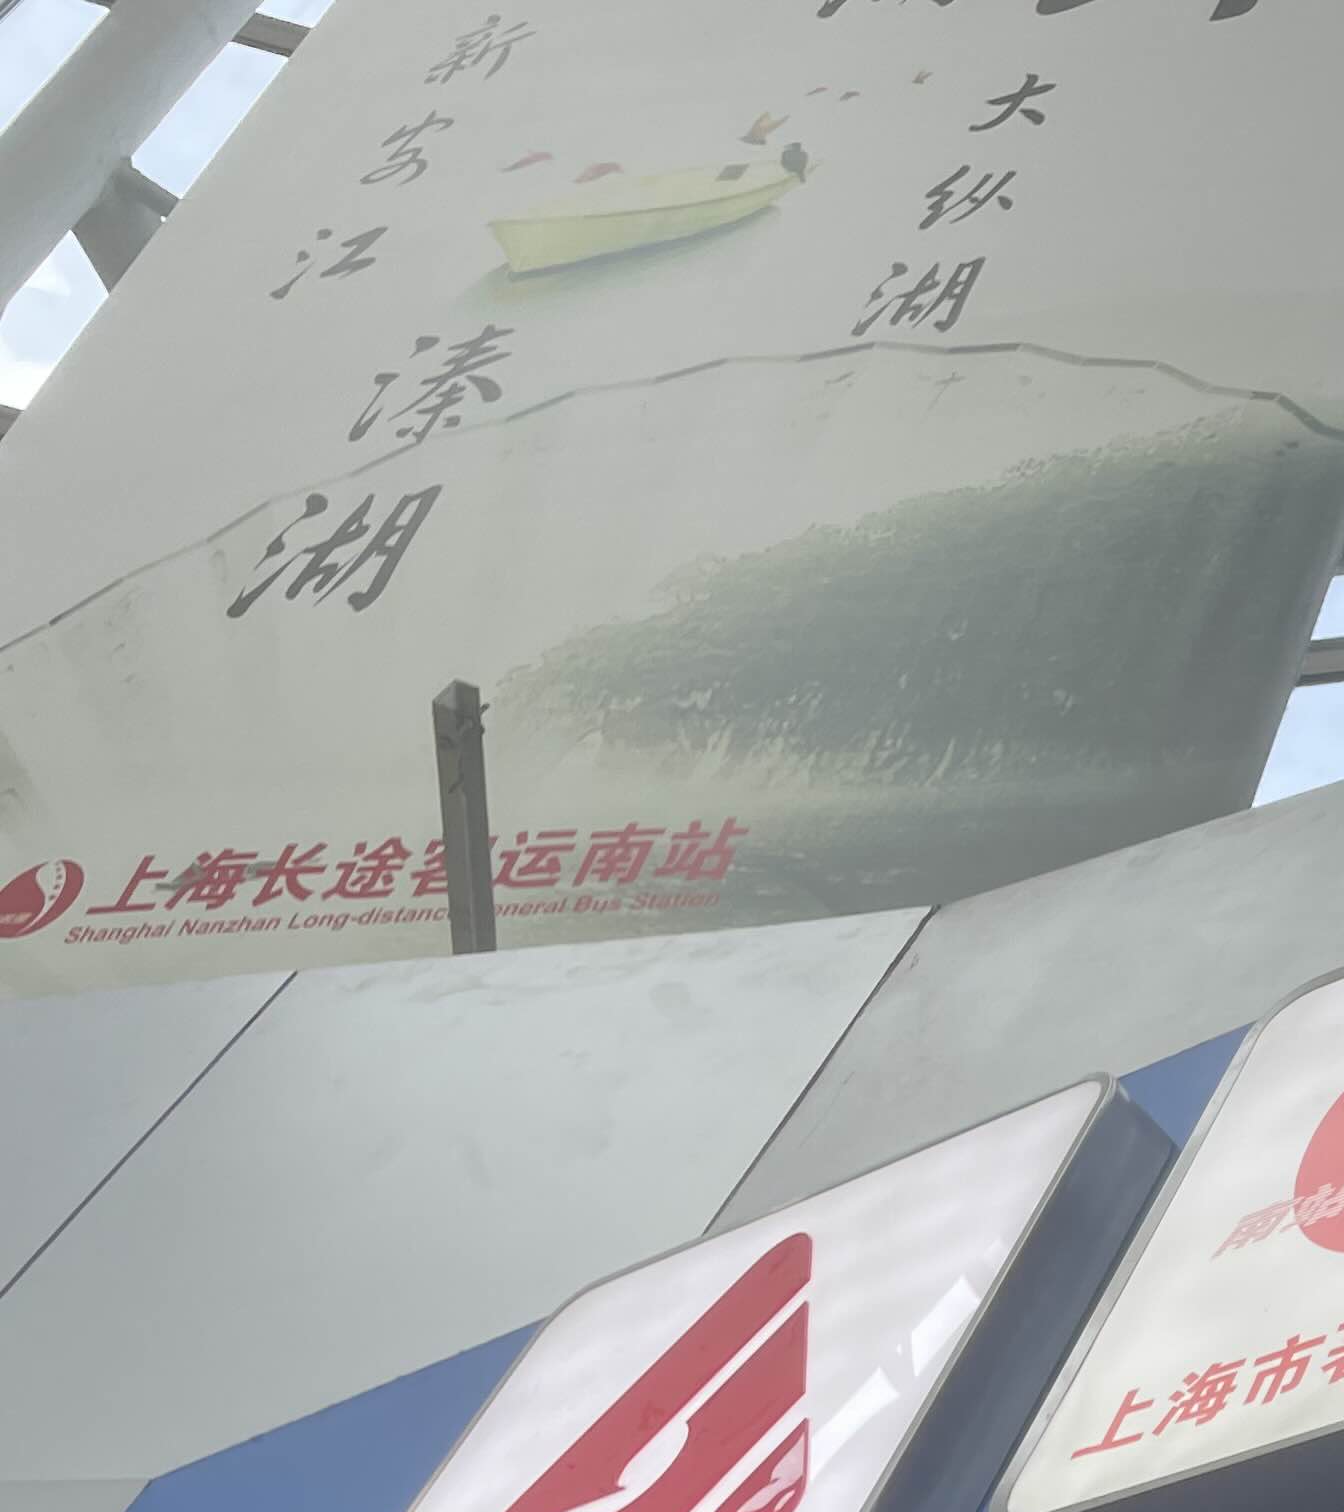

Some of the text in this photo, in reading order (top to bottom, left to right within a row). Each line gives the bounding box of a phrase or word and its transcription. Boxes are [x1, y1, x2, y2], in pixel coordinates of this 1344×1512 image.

[851, 73, 1056, 336] 大纵湖
[64, 920, 175, 945] Shanghai
[178, 916, 282, 936] Nanzhan
[288, 905, 451, 931] Long-distanc
[573, 894, 621, 913] Bus
[630, 890, 721, 912] Station
